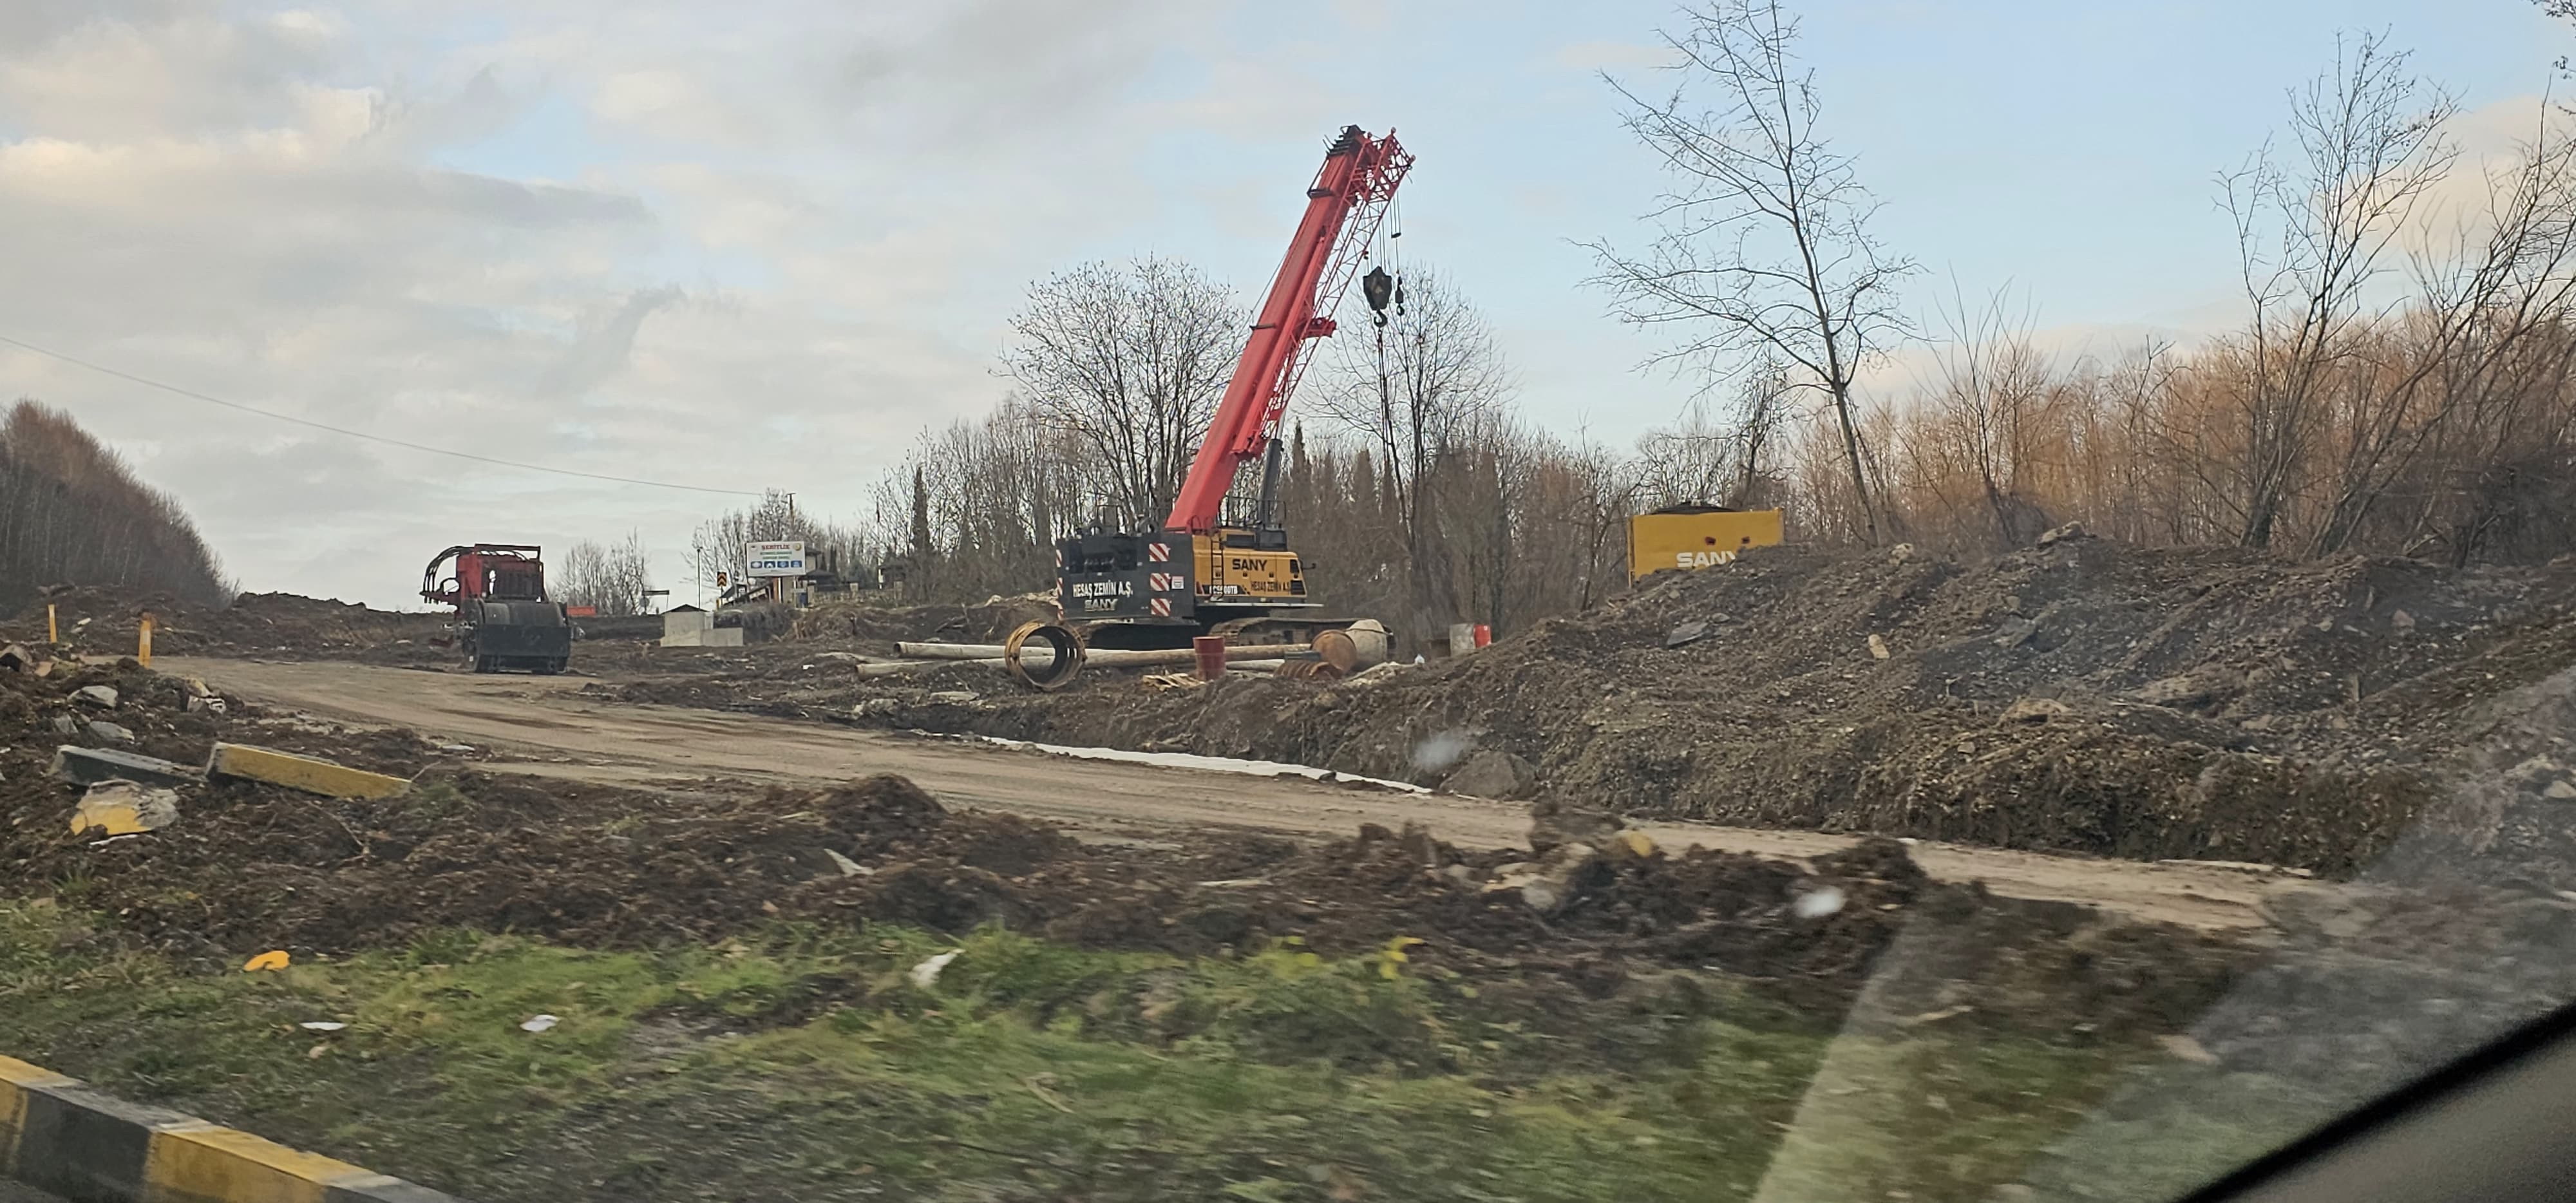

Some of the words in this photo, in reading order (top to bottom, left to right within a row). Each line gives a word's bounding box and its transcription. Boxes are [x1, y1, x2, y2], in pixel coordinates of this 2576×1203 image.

[1232, 558, 1267, 571] SANY
[1072, 583, 1093, 599] HESAŞ
[1094, 580, 1117, 596] ZEMİN
[1118, 581, 1133, 598] A.Ş.
[1084, 598, 1118, 611] SANY
